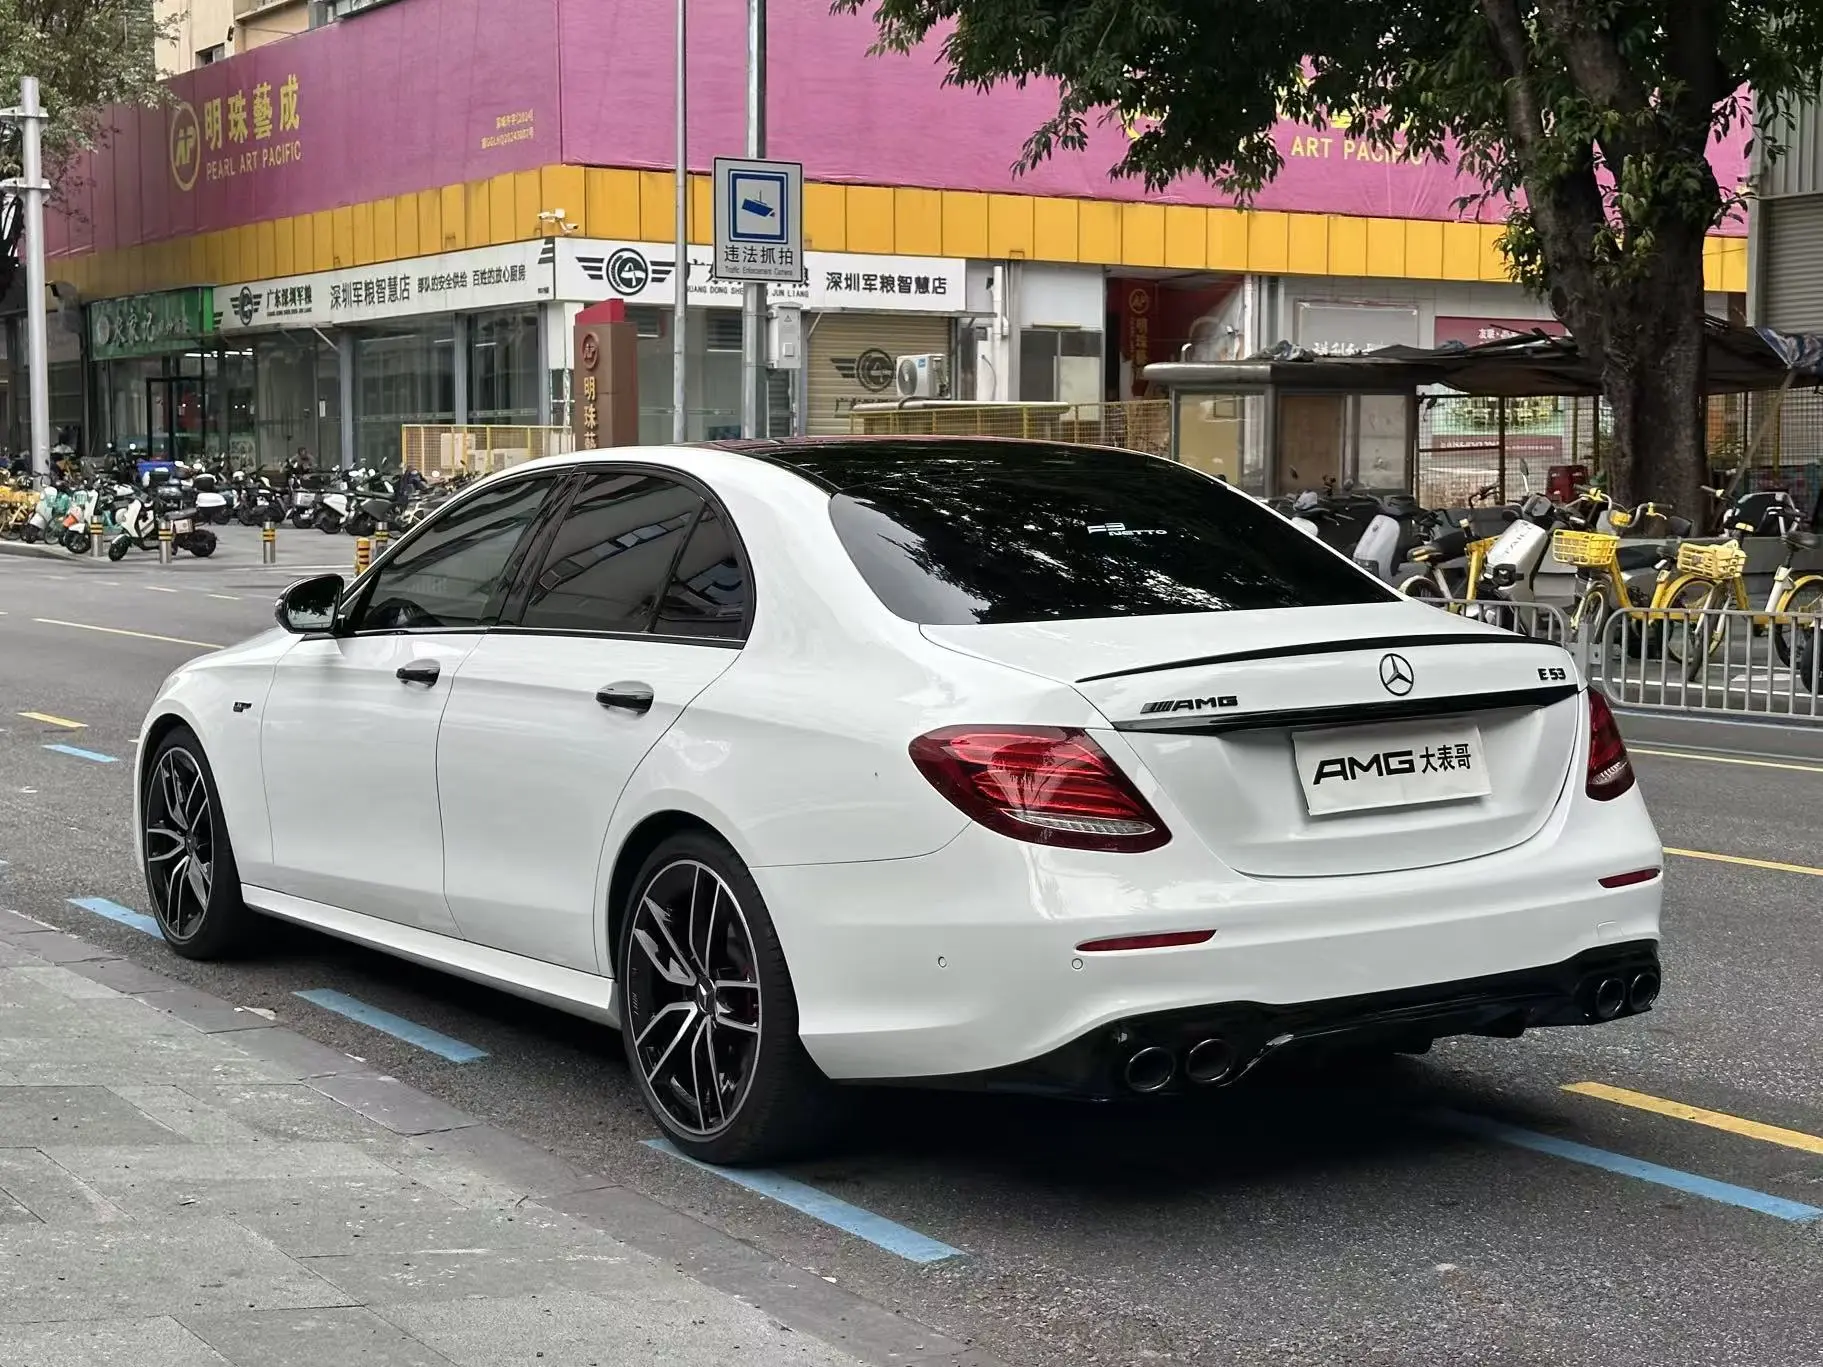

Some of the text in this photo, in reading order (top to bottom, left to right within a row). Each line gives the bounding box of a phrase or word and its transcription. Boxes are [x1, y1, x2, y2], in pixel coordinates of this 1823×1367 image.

[204, 73, 300, 150] 明珠藝成
[206, 140, 301, 181] PEARL ART PACIFIC
[1290, 136, 1424, 165] ART PACIFC
[723, 244, 794, 266] 违法抓拍
[330, 273, 411, 311] 深圳军粮智慧店
[417, 264, 526, 293] 部队的安全供给 百姓的放心厨房
[709, 285, 728, 294] DONG
[771, 289, 785, 298] JUN
[787, 290, 809, 299] LIANG
[826, 271, 947, 295] 深圳军粮智慧店
[1419, 743, 1472, 774] 大表哥
